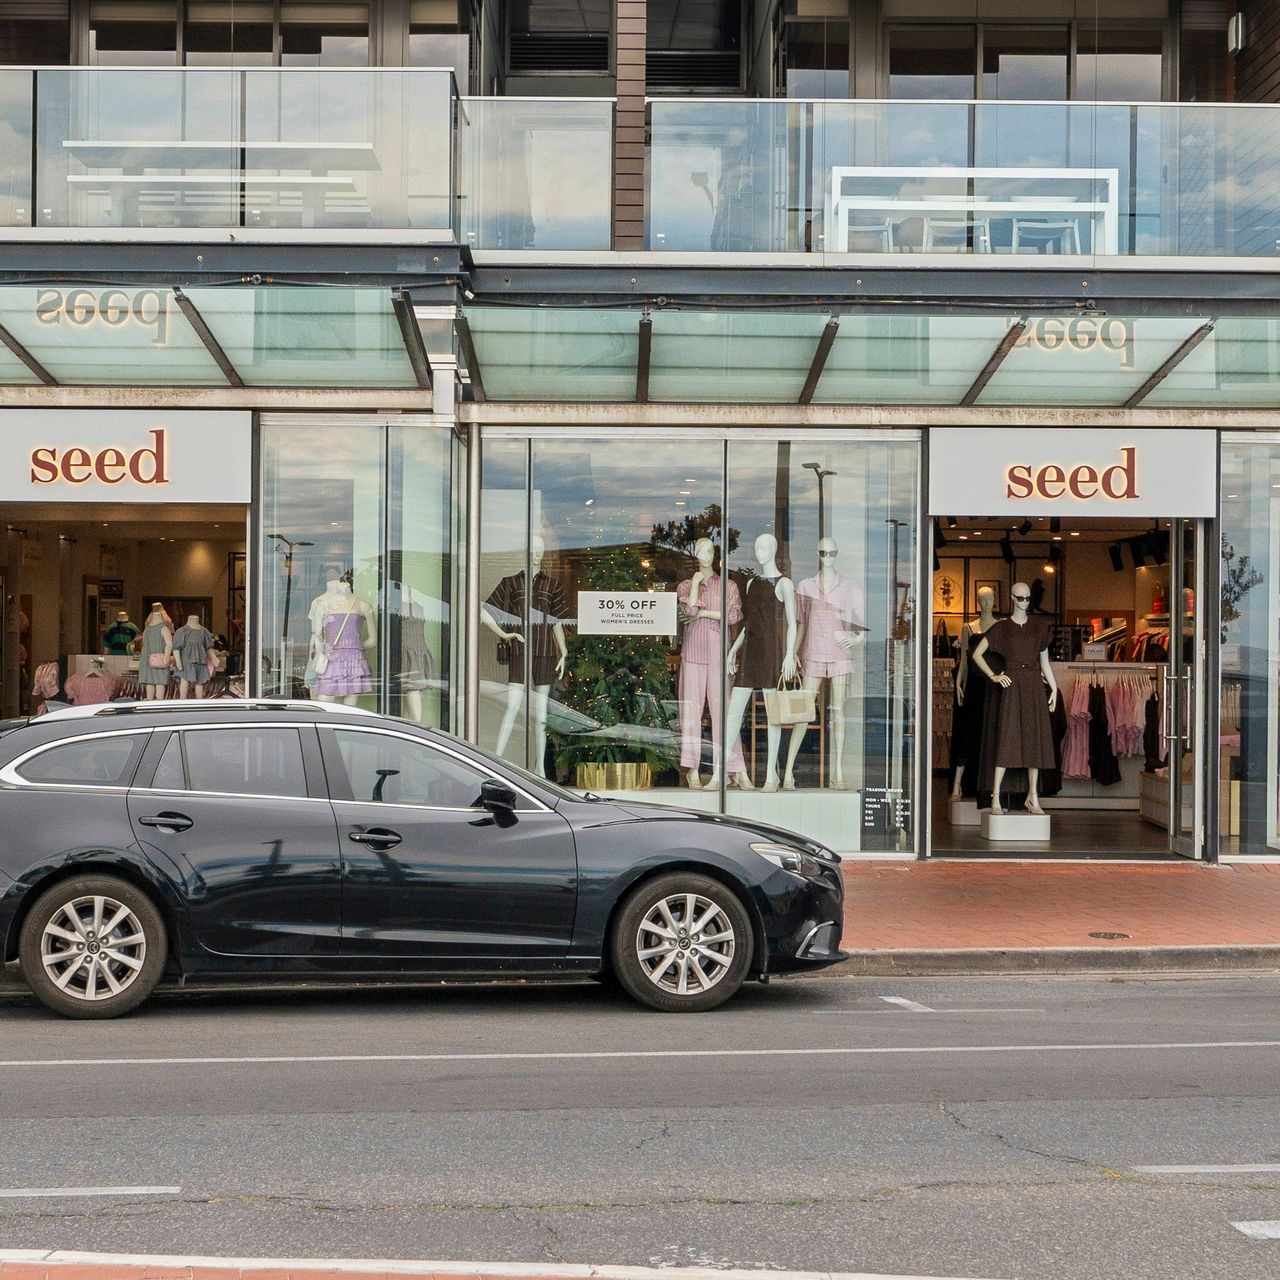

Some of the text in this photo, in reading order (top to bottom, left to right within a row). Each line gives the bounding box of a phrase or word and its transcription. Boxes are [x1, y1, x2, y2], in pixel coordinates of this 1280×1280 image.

[30, 428, 169, 484] seed
[1007, 447, 1140, 499] seed
[598, 600, 657, 610] 30% OFF
